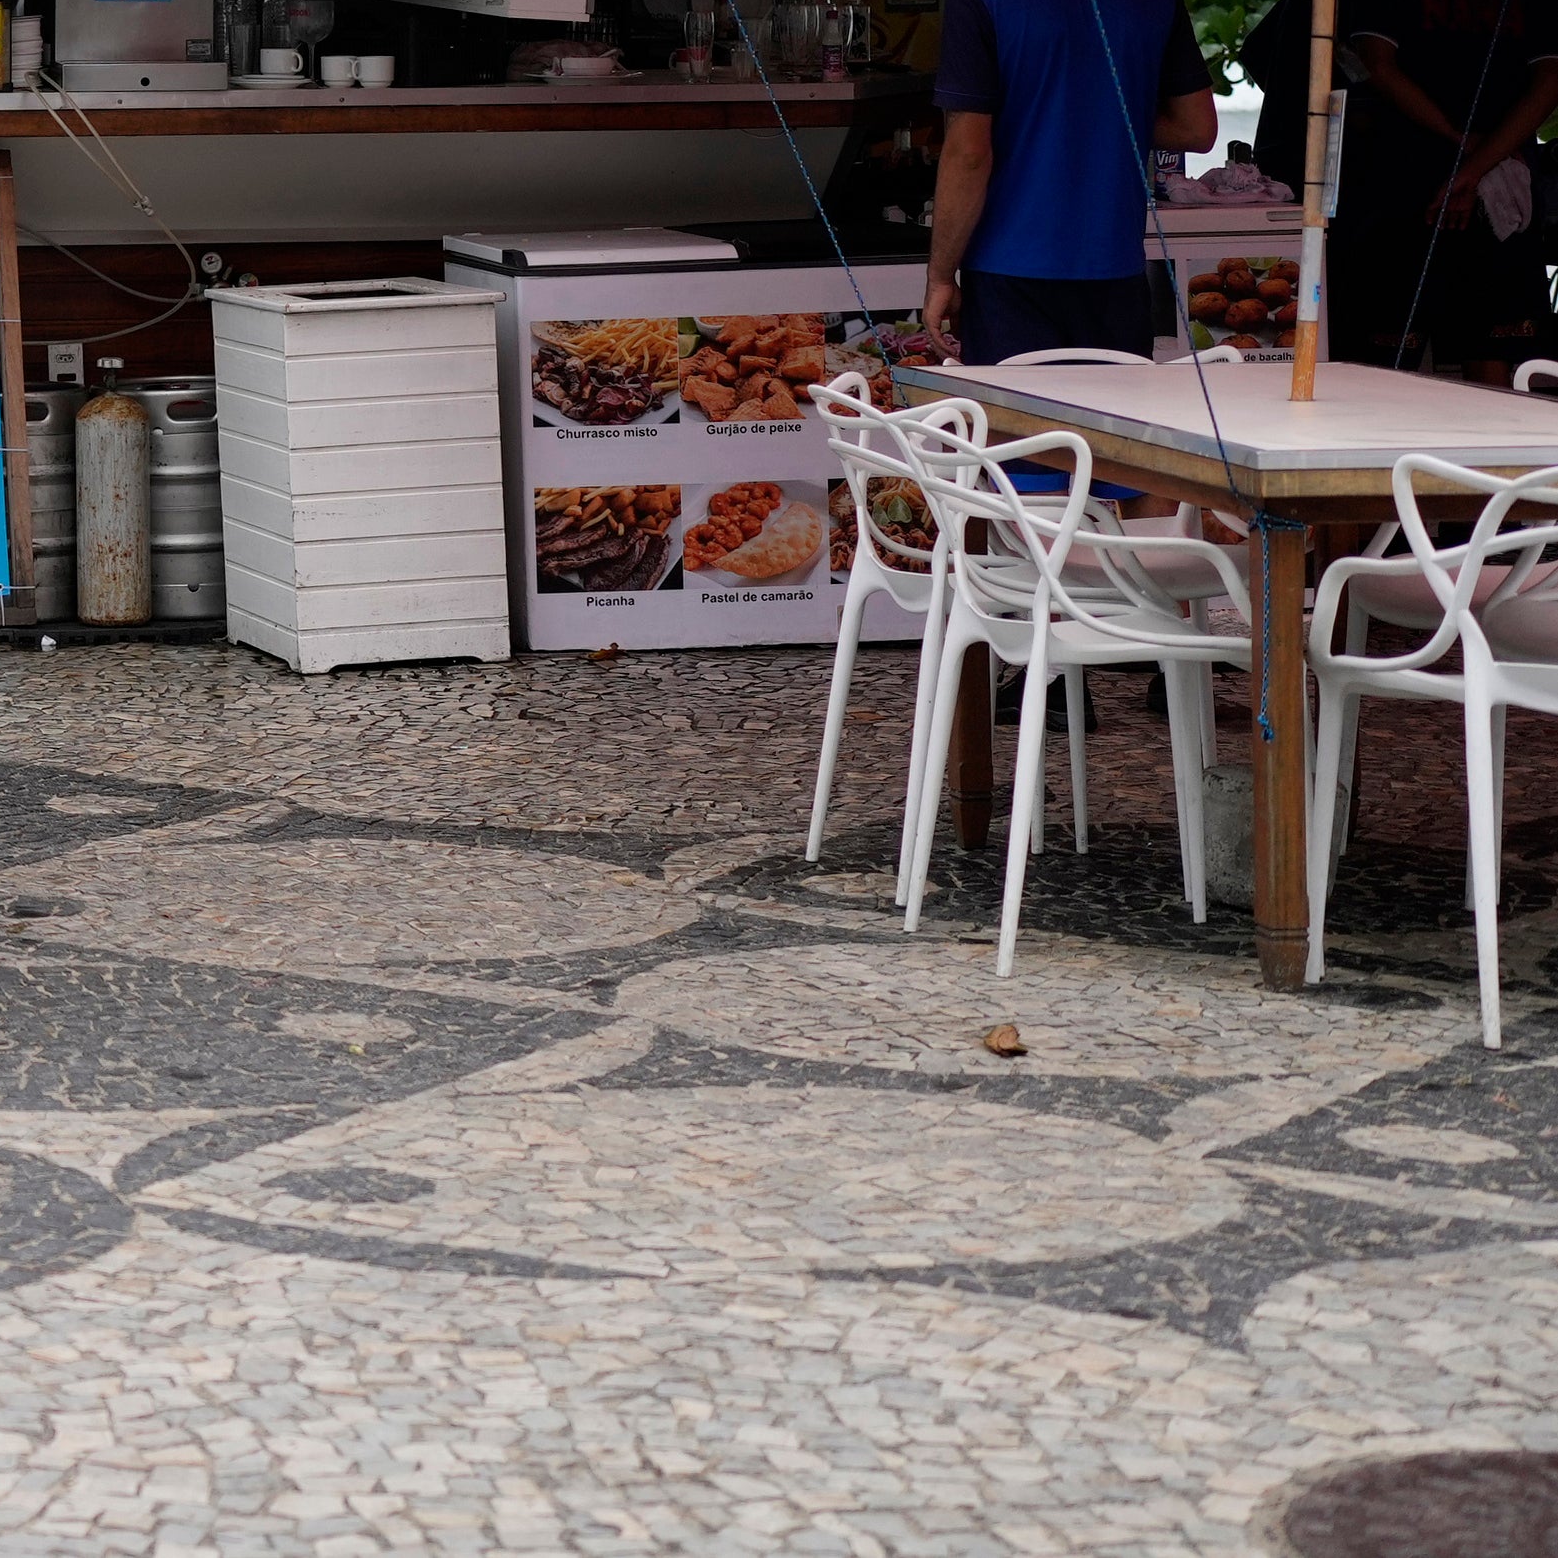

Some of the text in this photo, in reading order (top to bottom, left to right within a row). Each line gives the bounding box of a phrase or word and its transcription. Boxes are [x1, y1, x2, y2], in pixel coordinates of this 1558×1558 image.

[1156, 151, 1180, 167] Vim
[1244, 352, 1258, 362] de
[556, 426, 658, 440] Churrasco misto
[706, 422, 802, 436] Gurjão de peixe
[586, 595, 635, 607] Picanha
[701, 589, 814, 604] Pastel de camarão
